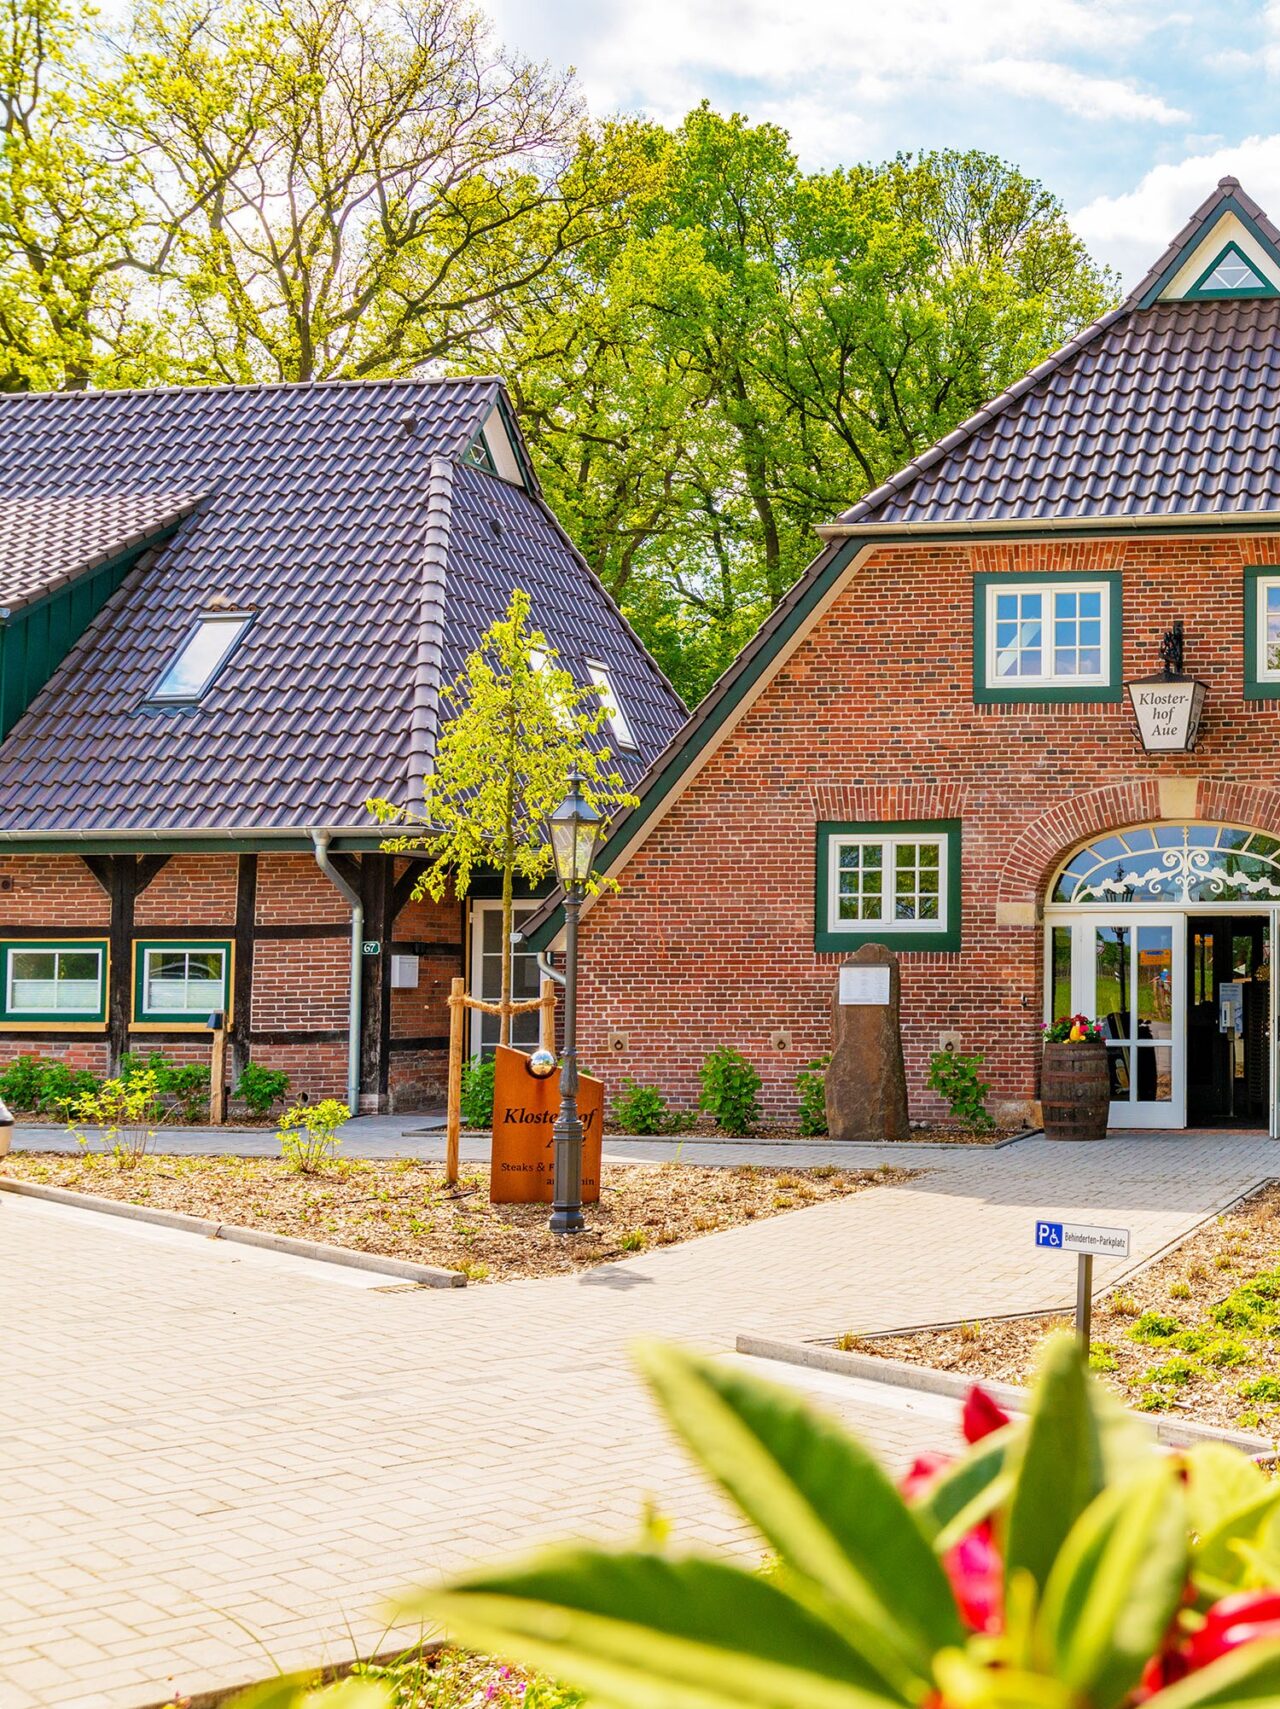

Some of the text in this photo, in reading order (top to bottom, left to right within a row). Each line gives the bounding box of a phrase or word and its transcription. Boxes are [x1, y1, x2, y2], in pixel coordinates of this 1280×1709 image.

[1139, 692, 1189, 706] Kloster-
[1152, 706, 1175, 725] hof
[1151, 725, 1178, 737] Aue
[363, 943, 376, 953] 67
[503, 1107, 598, 1132] Klosteof
[501, 1162, 534, 1172] Steaks
[536, 1162, 545, 1172] &
[1064, 1231, 1126, 1249] Behinderten-Parkplatz
